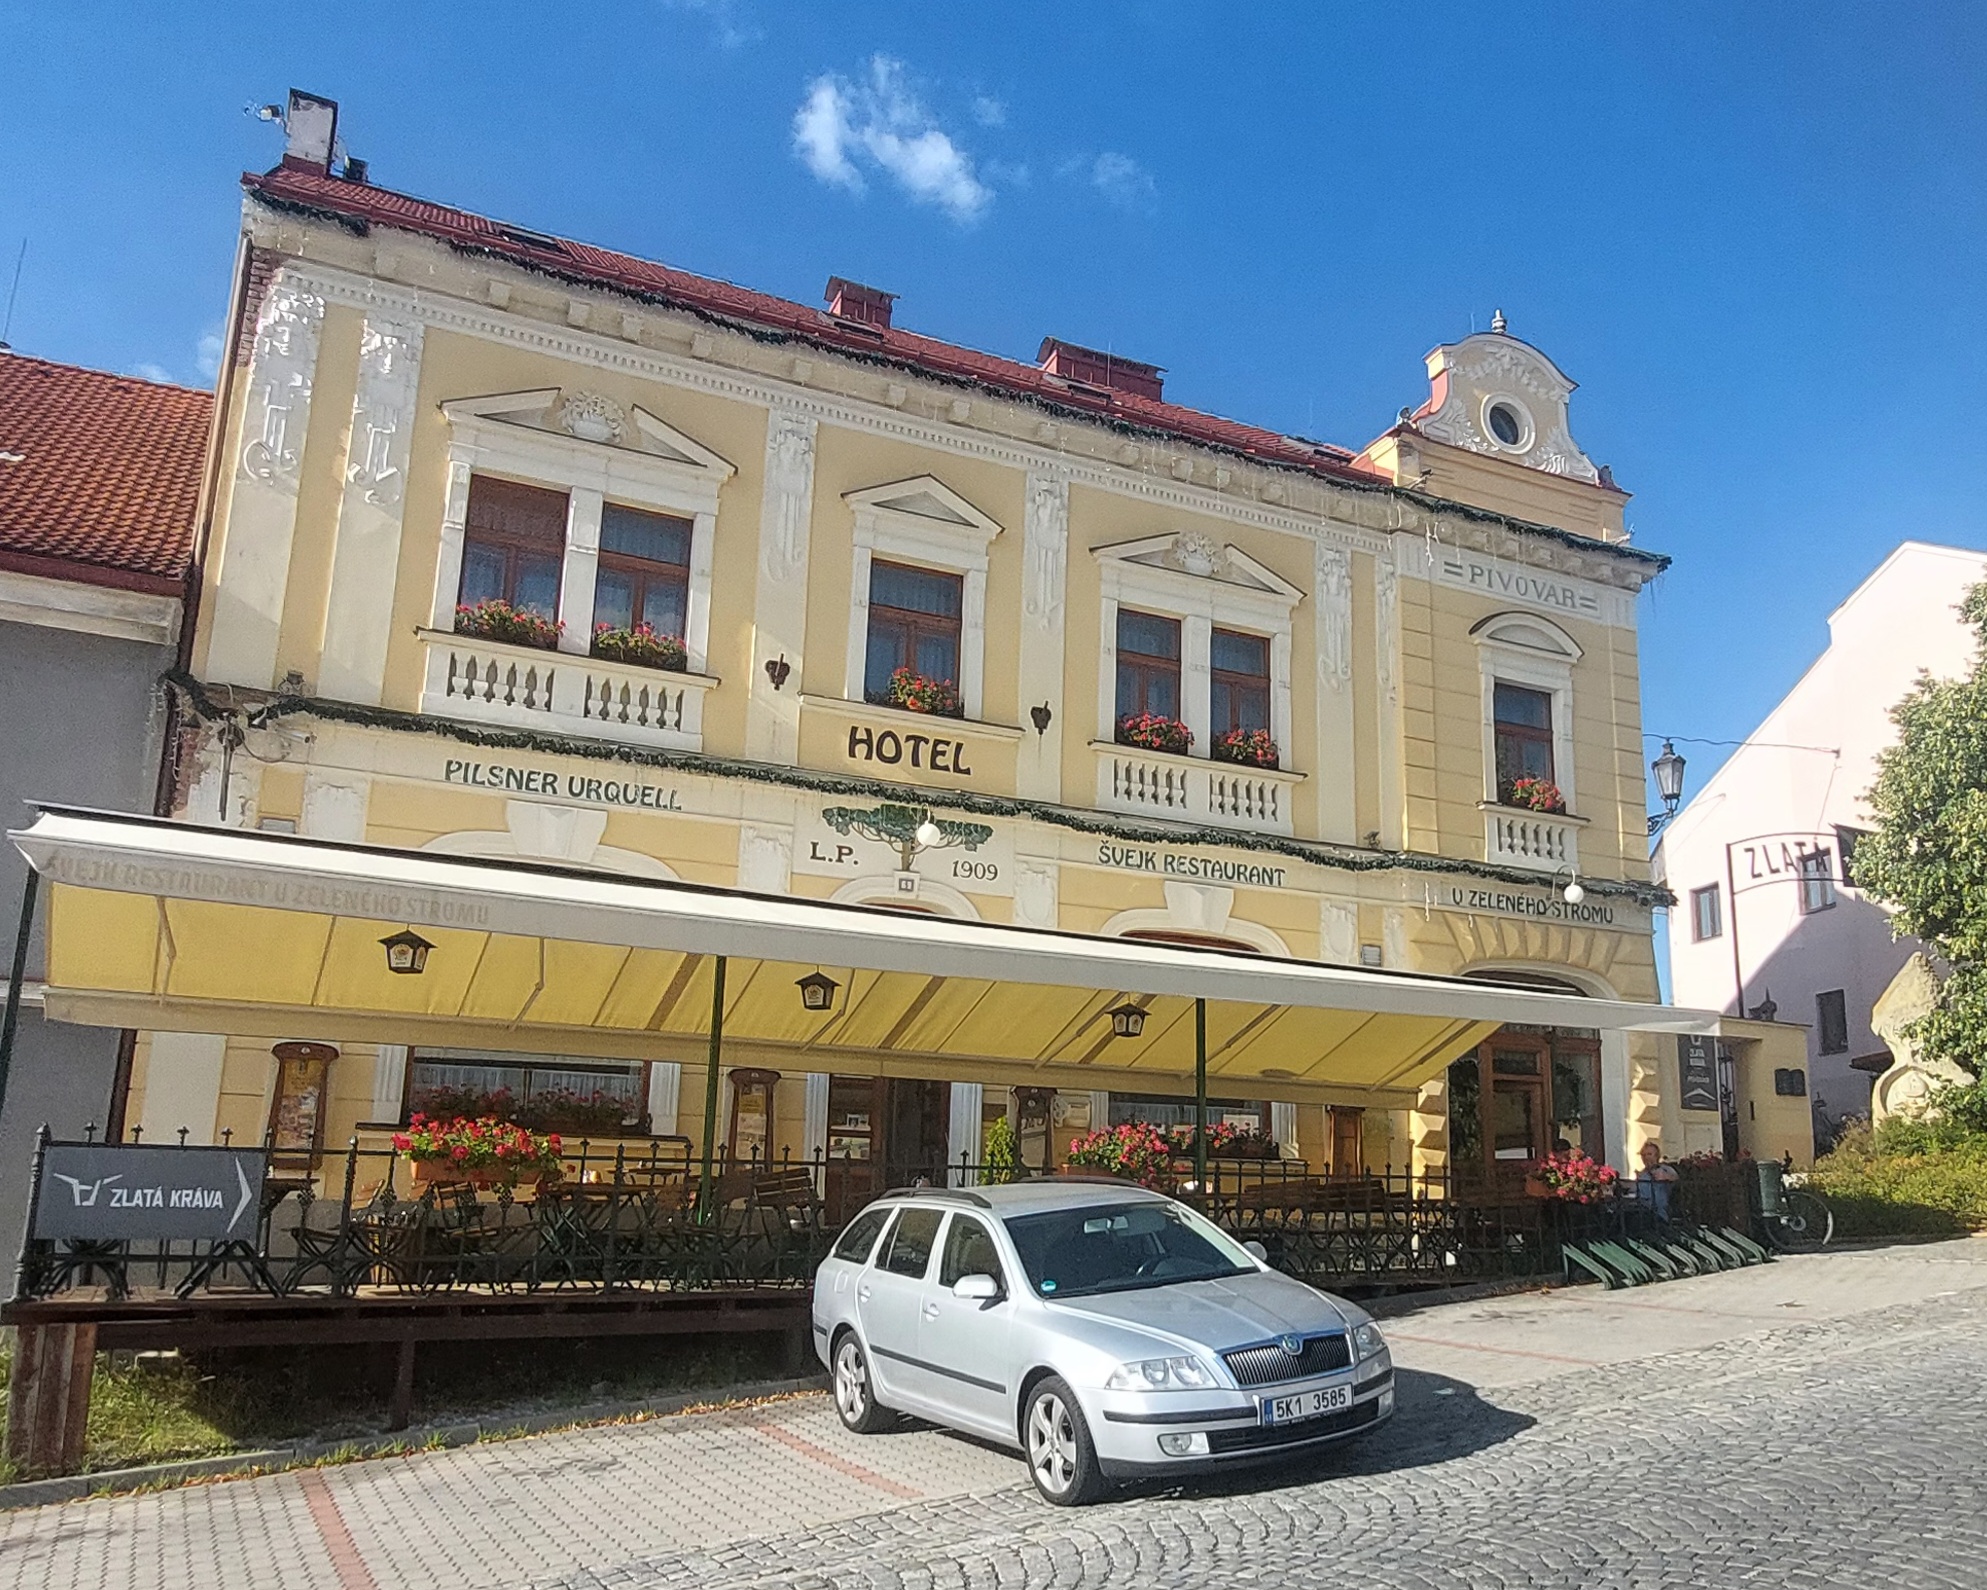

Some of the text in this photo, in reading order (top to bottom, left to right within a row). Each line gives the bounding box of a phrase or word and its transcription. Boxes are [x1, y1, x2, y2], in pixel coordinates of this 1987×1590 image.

[1468, 563, 1578, 609] PIVOVAR
[848, 726, 972, 776] HOTEL
[444, 759, 683, 811] PILSNER URQUELL
[809, 841, 999, 881] L.P. 1909
[1098, 839, 1286, 887] ŠVEJK RESTAURANT
[406, 898, 489, 925] STROMU
[1452, 887, 1614, 924] U ZELENÉHO STROMU
[109, 1185, 224, 1209] ZLATÁ KRÁVA
[1276, 1396, 1303, 1419] 5K1
[1313, 1387, 1347, 1411] 3585
